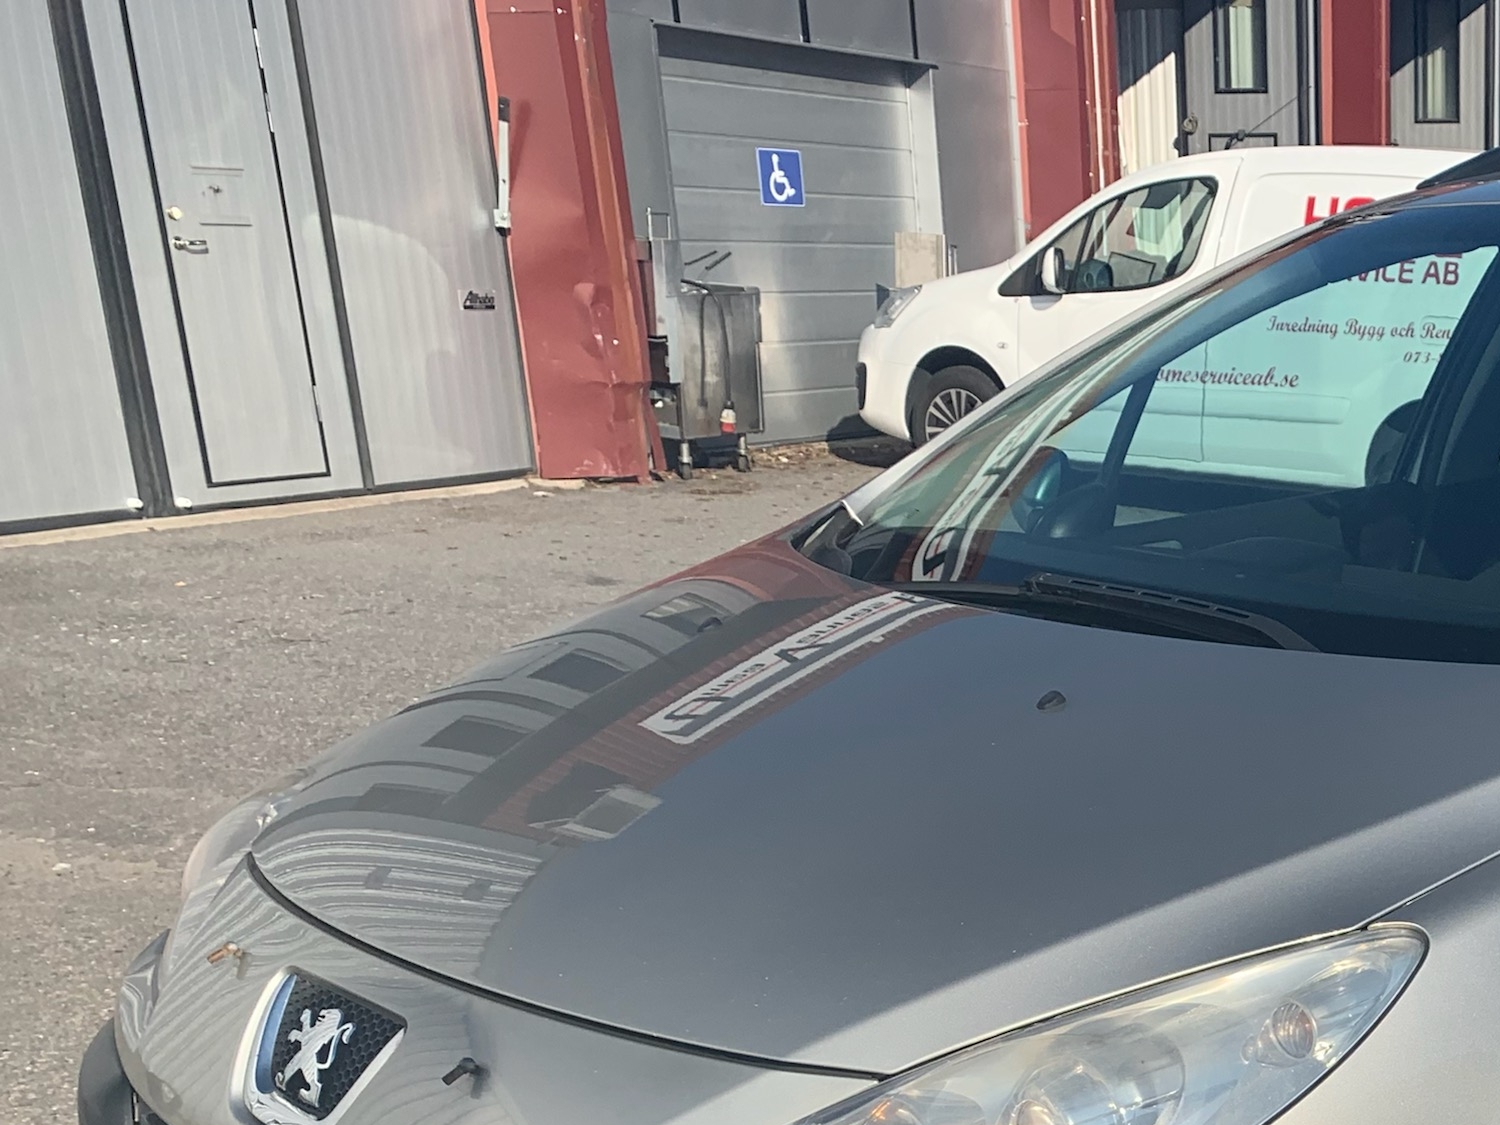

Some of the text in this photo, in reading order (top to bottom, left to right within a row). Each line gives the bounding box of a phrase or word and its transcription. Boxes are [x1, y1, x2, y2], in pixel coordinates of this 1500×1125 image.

[1421, 260, 1459, 285] AB
[1266, 315, 1338, 340] Inredning
[1343, 318, 1385, 341] Bygg
[1390, 321, 1415, 338] och
